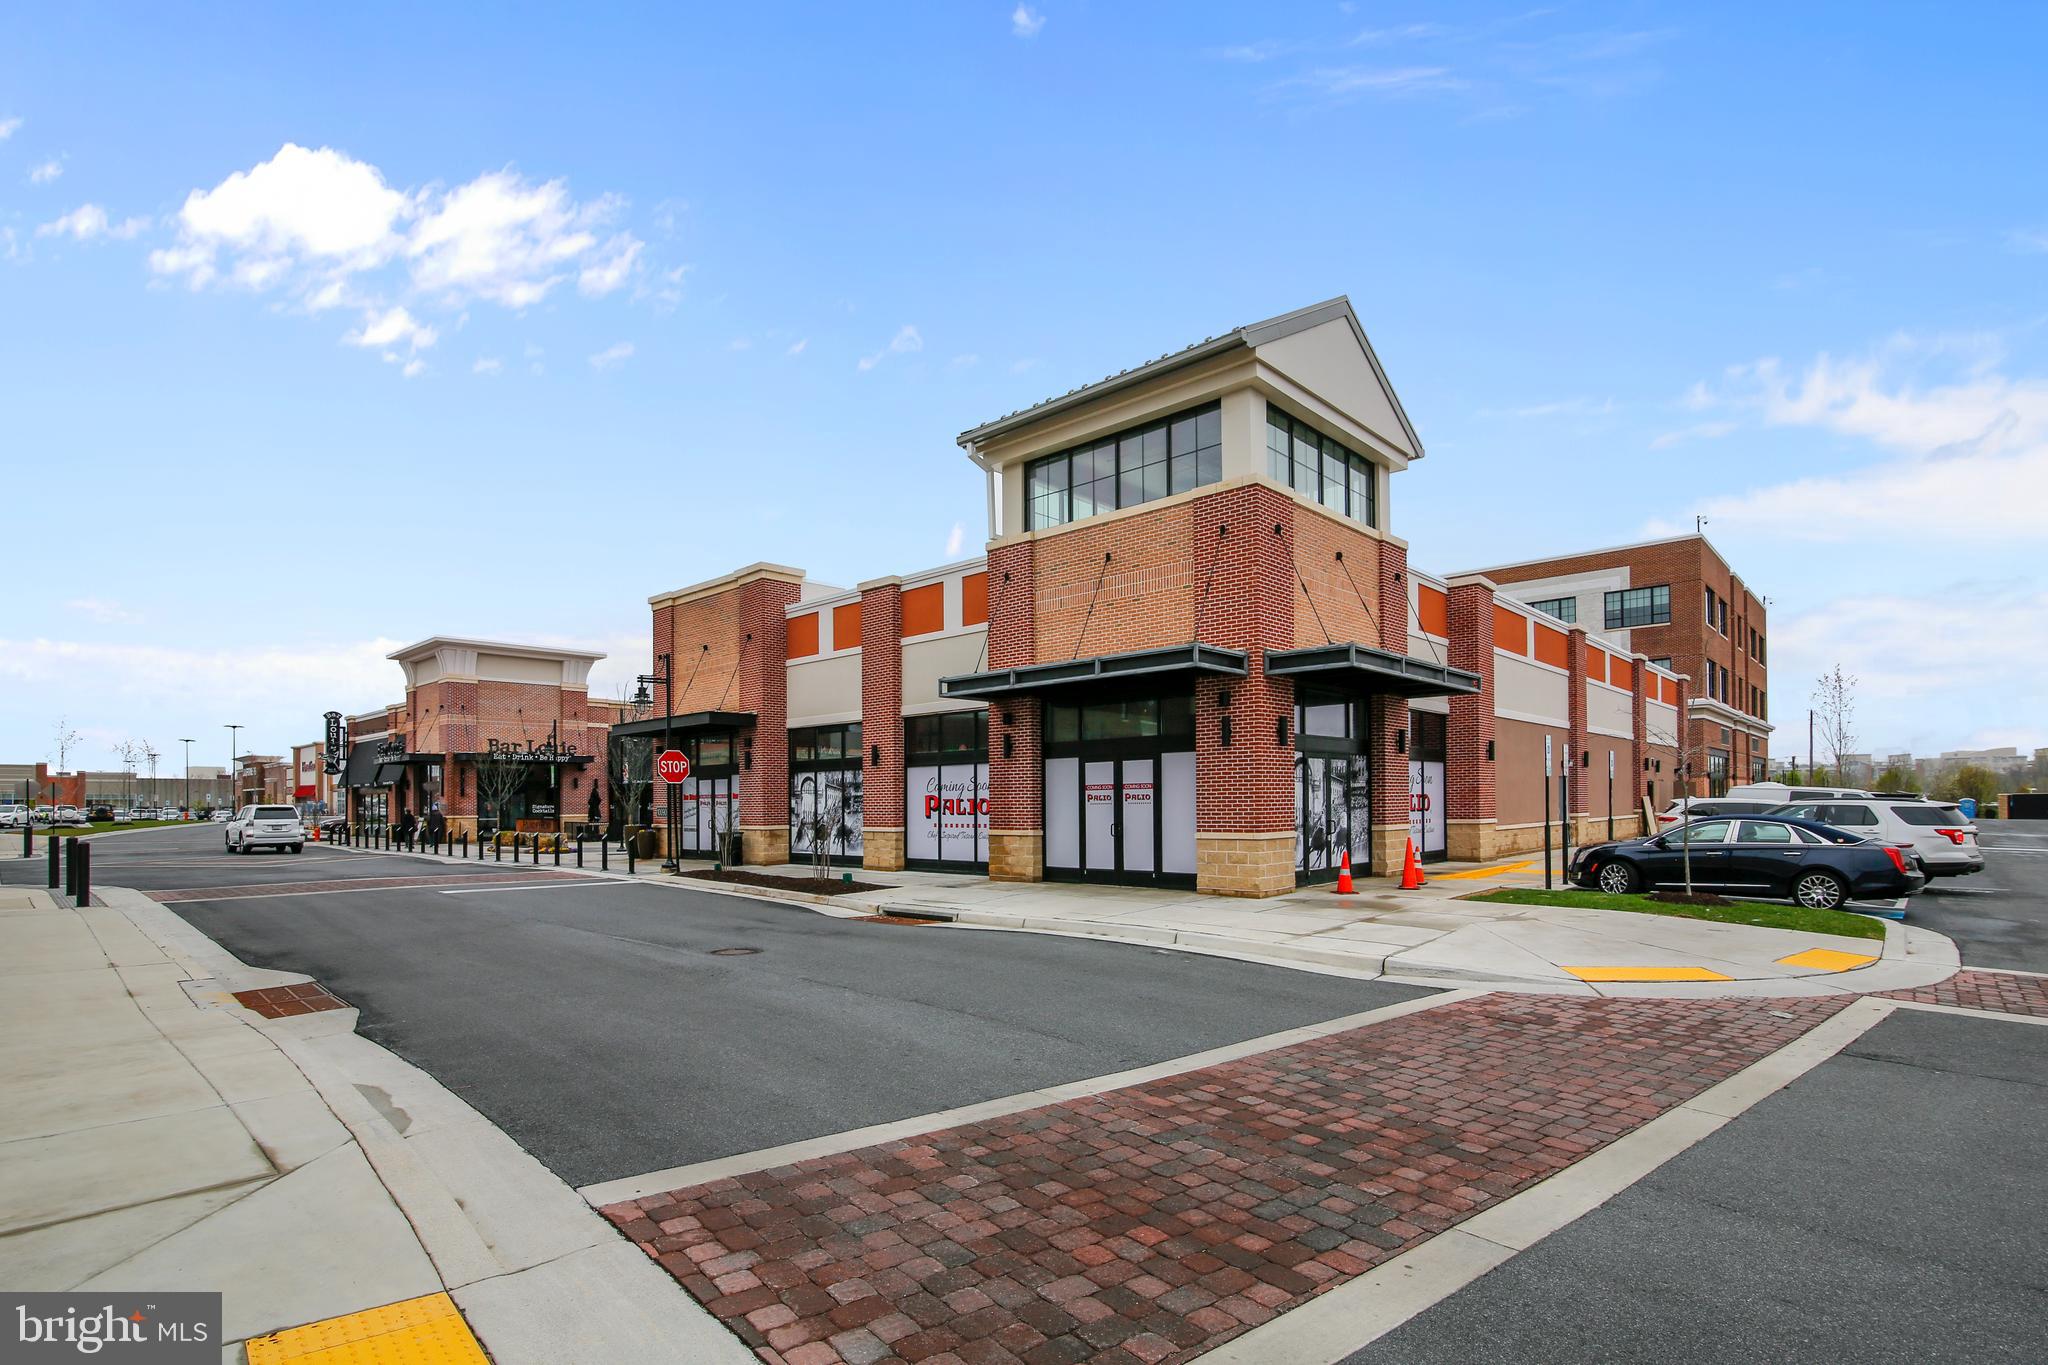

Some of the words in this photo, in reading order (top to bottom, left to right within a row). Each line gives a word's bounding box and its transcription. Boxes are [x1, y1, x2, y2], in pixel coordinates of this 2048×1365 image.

[487, 738, 522, 753] Bar
[512, 753, 534, 761] Drink
[549, 754, 571, 763] Hppy
[660, 760, 688, 773] STOP
[926, 776, 965, 800] Coming
[1087, 793, 1112, 802] PALIO
[1125, 793, 1151, 802] PALIO
[1409, 794, 1431, 812] LIO
[925, 794, 990, 819] PALIO
